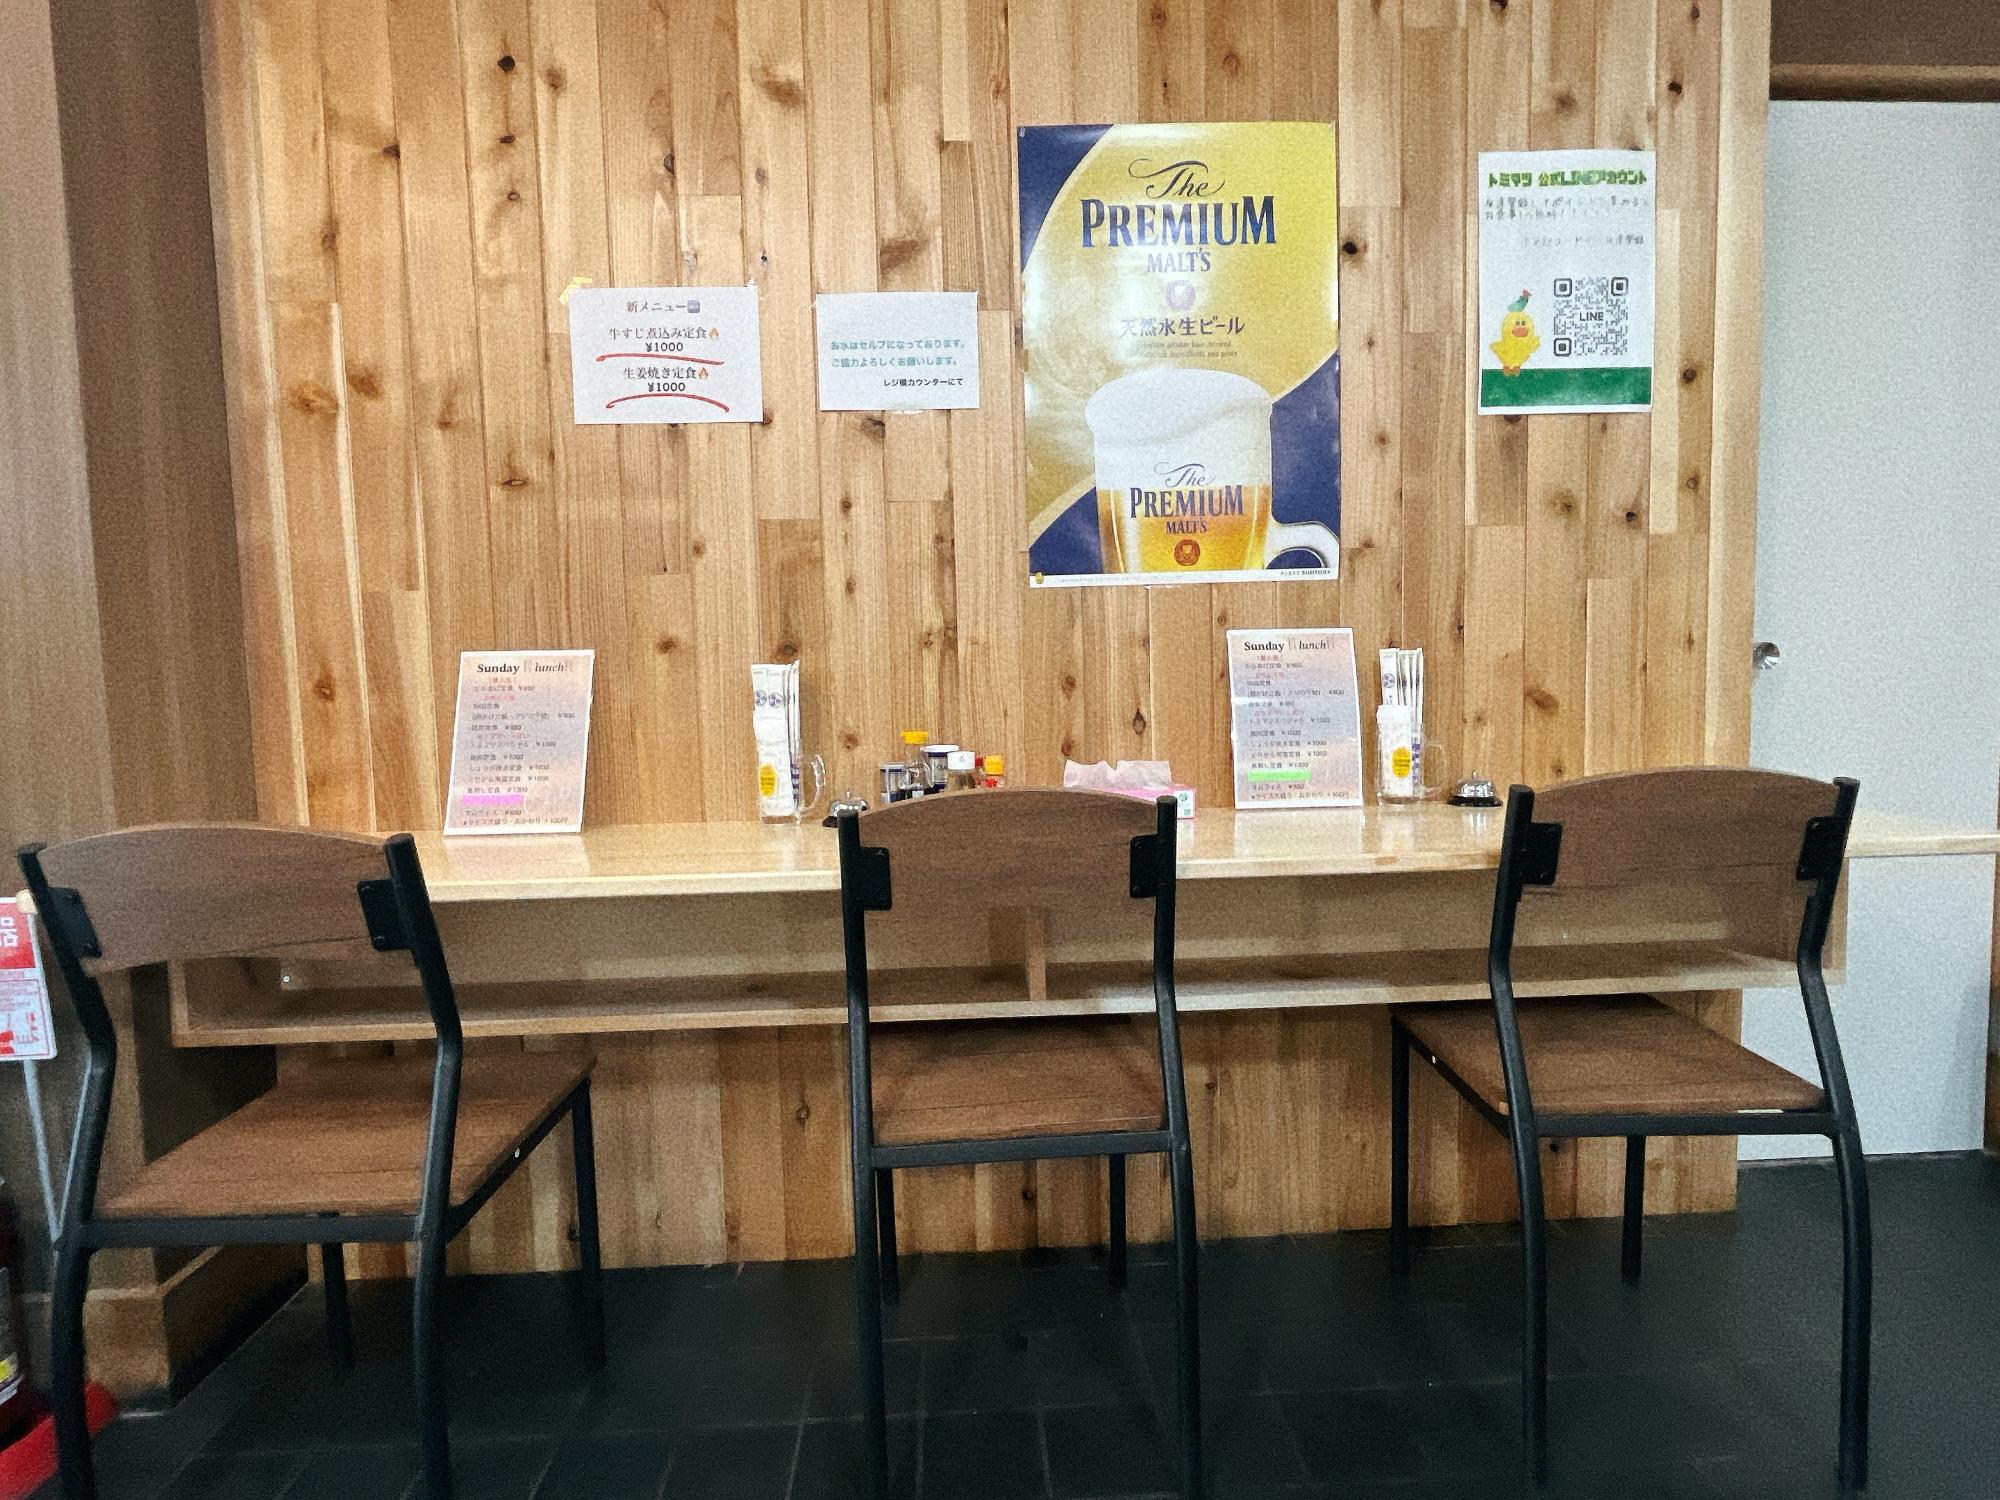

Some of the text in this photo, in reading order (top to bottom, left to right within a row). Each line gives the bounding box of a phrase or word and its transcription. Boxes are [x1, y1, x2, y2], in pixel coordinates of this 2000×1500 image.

[1128, 158, 1226, 198] The
[1080, 195, 1277, 248] PREMIUM
[1146, 248, 1212, 273] MALT'S
[626, 300, 687, 313] 新メニュー
[1579, 311, 1604, 322] LINE
[608, 326, 707, 340] 牛すじ煮込み定食
[1120, 315, 1246, 337] 天然水生ビール
[645, 341, 684, 352] ¥1000
[830, 339, 966, 351] お水はセルフになっております。
[831, 356, 958, 368] ご協力よろしくお願いします。
[623, 366, 697, 380] 生姜焼き定食
[647, 382, 686, 392] ¥1000
[1153, 462, 1216, 487] The
[1130, 485, 1244, 518] PREMIUM
[1165, 517, 1208, 535] MALT'S
[1244, 640, 1327, 652] Sunday lunch
[477, 662, 564, 674] Sunday lunch
